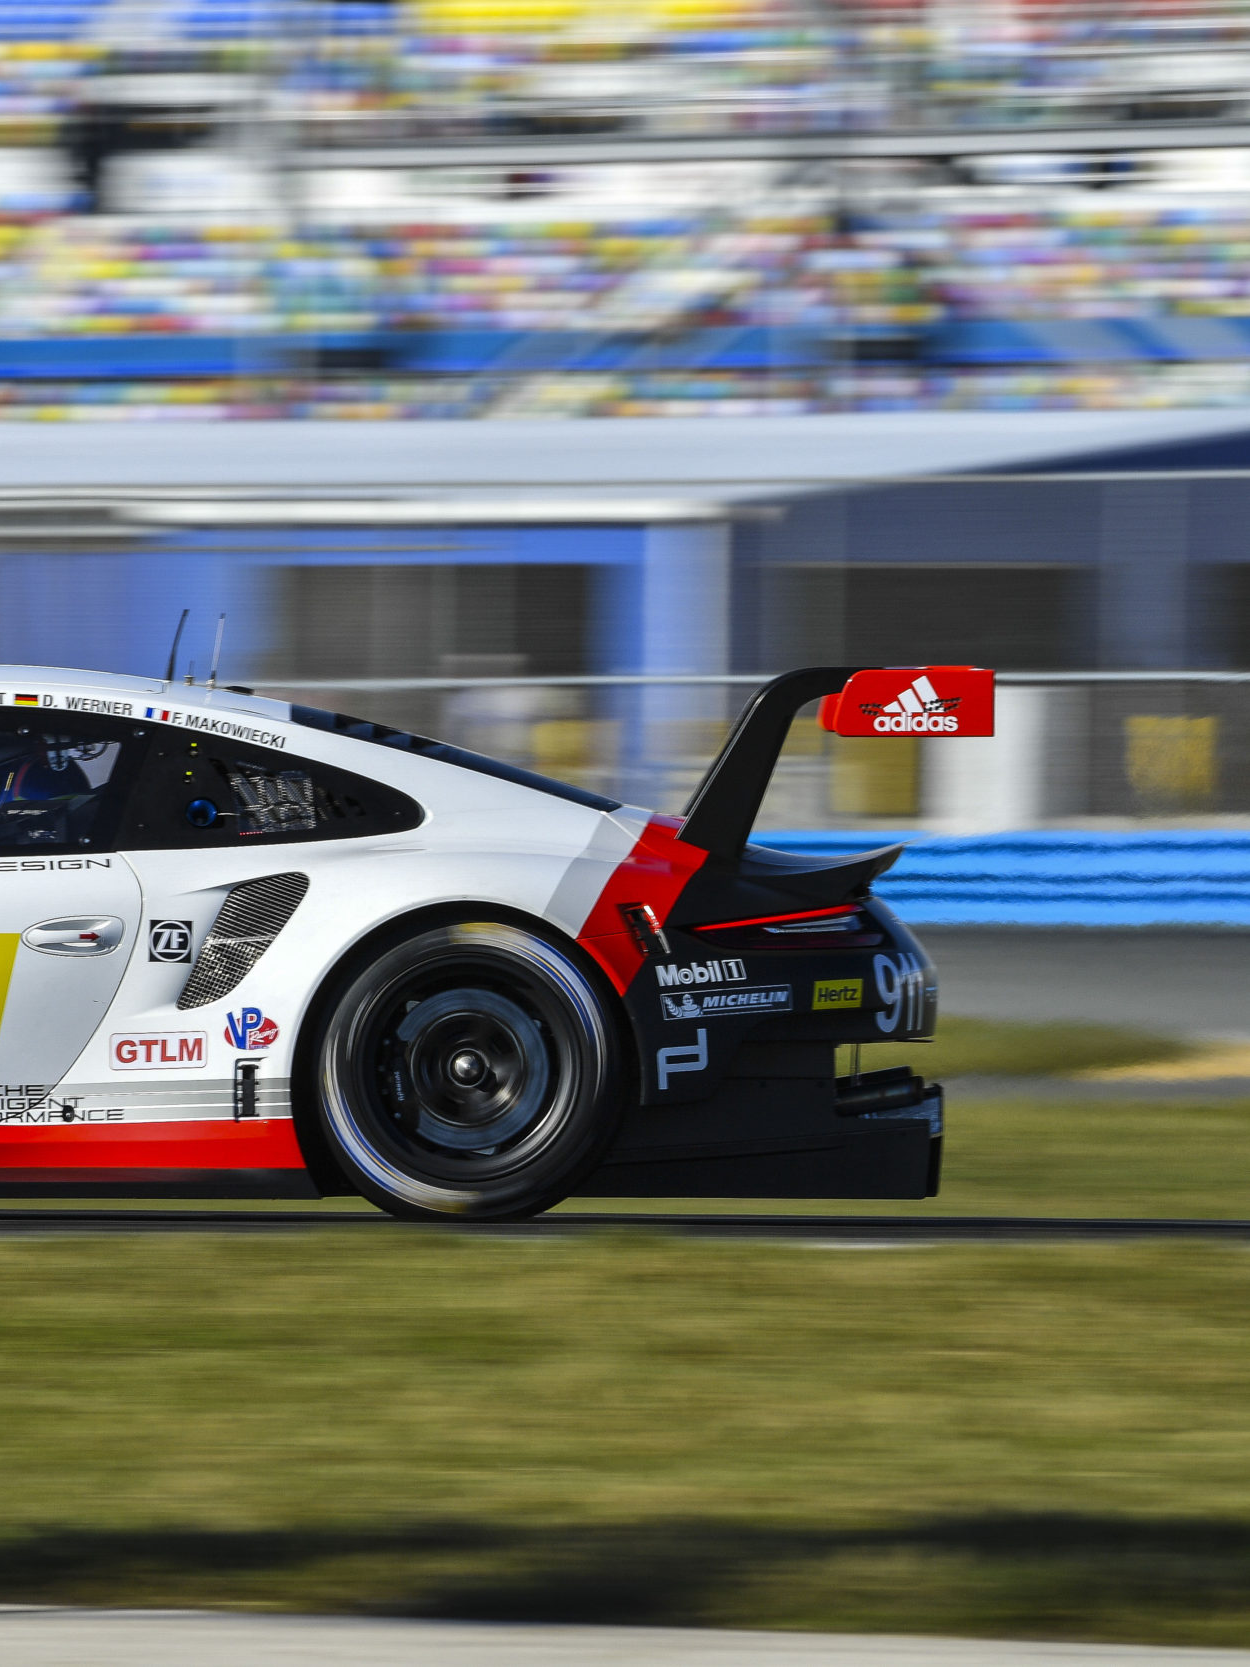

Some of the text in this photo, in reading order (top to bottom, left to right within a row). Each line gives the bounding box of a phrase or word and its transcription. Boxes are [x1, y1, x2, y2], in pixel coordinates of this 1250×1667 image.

[43, 695, 133, 716] D. WERNER
[185, 714, 287, 749] MAKOWIECKI
[873, 712, 959, 732] adidas
[655, 961, 723, 987] Mobil
[702, 991, 789, 1008] MICHELIN
[818, 986, 858, 1003] Hertz
[873, 953, 924, 1033] 911
[226, 1007, 262, 1050] VP
[116, 1038, 203, 1064] GTLM
